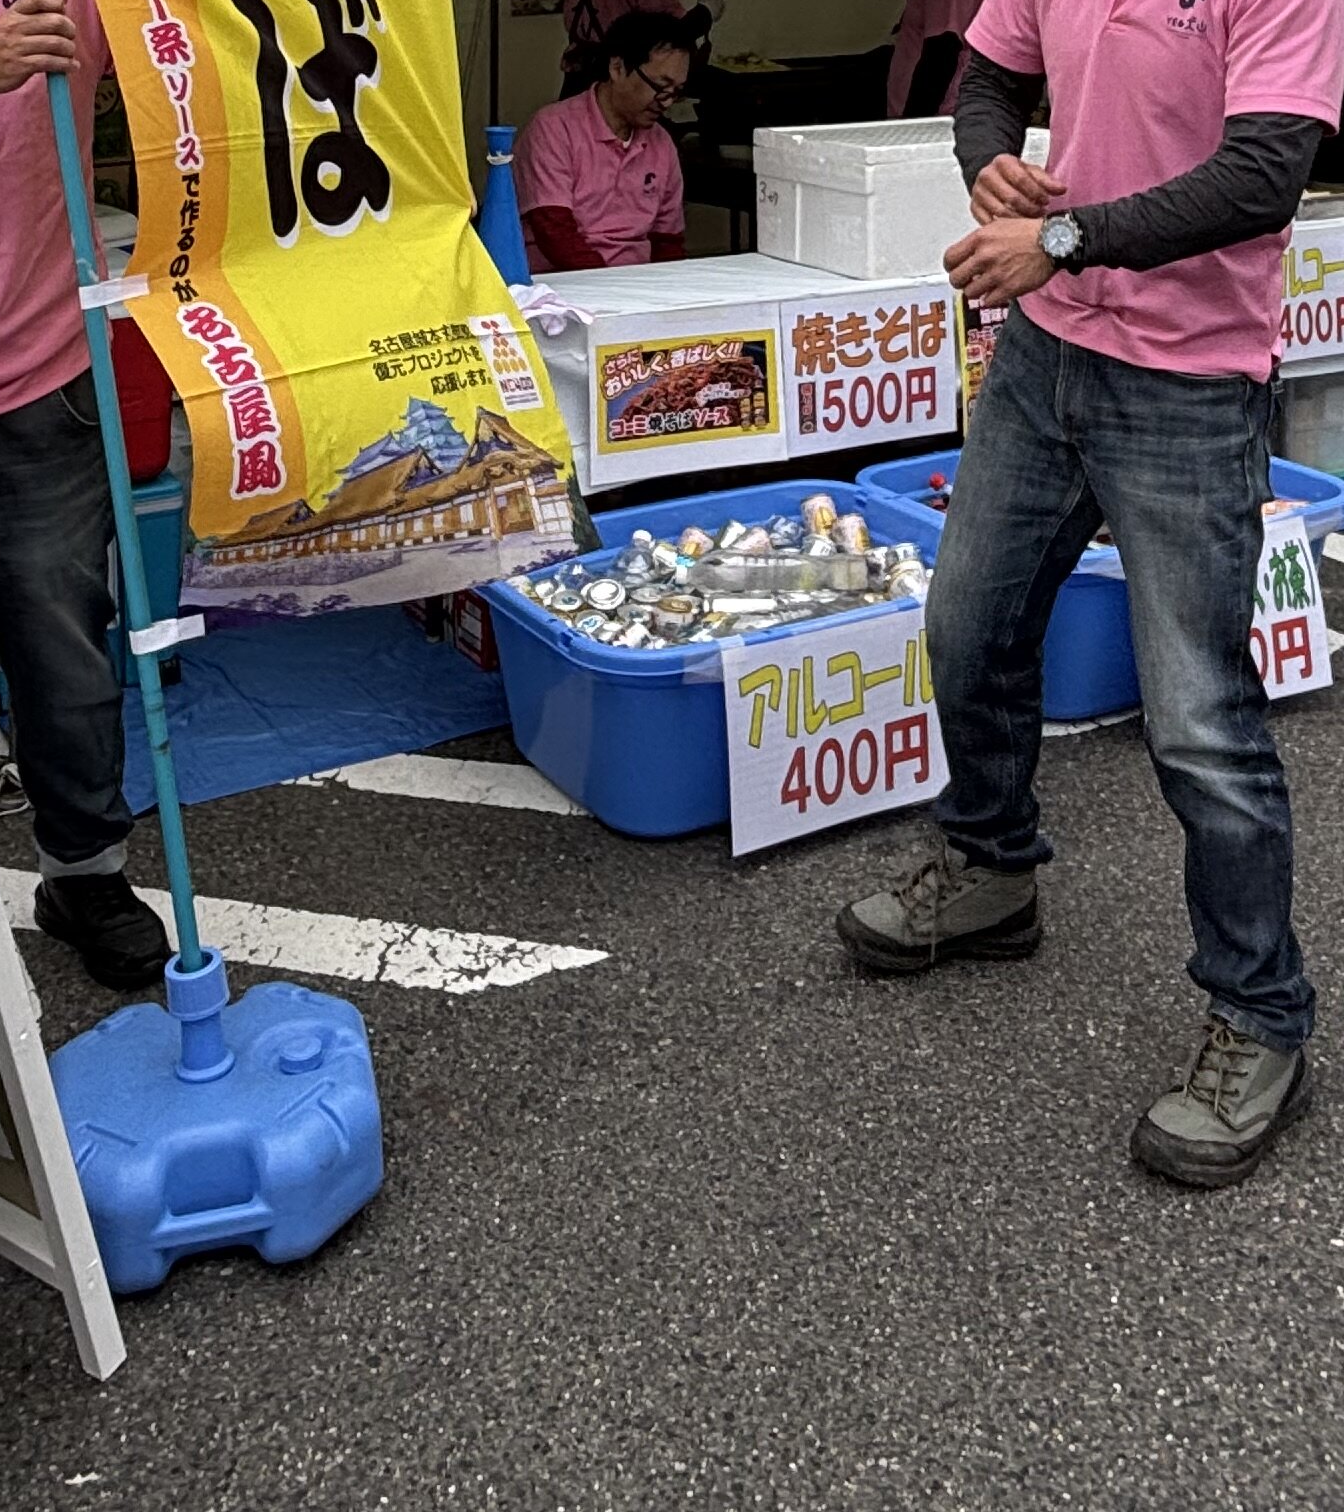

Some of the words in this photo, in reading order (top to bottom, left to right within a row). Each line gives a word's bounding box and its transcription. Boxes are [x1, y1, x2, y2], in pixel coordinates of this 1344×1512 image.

[372, 346, 484, 382] 復元プロジェクトを
[791, 299, 947, 377] 焼きそば
[430, 368, 493, 395] 応援します。
[822, 366, 938, 433] 500円
[608, 406, 732, 439] コーミ焼そばソース
[737, 627, 935, 749] アルコール
[780, 712, 930, 814] 400円
